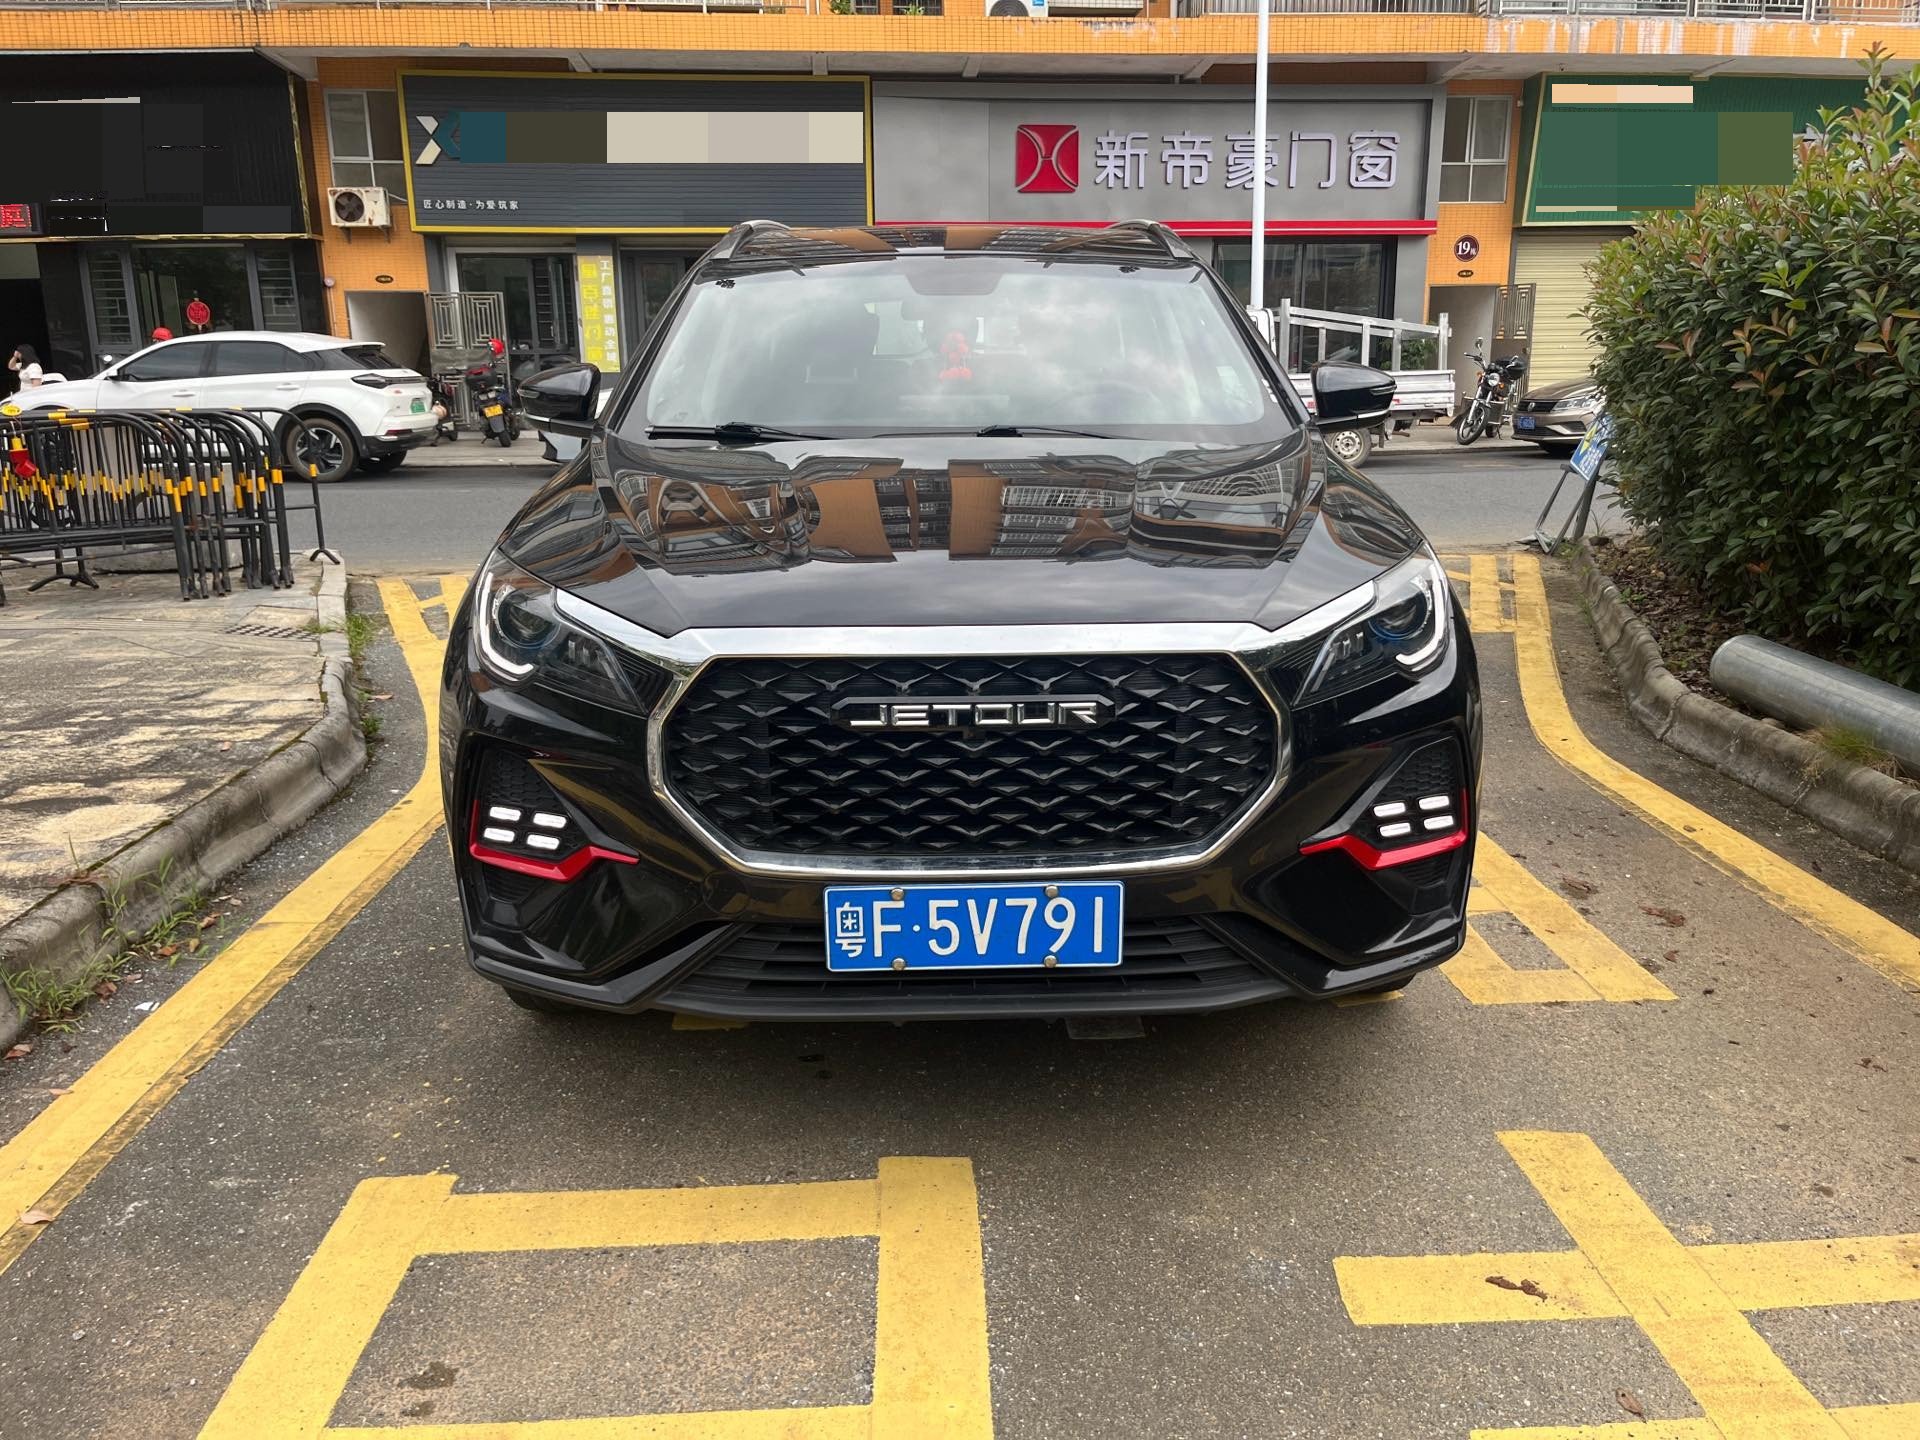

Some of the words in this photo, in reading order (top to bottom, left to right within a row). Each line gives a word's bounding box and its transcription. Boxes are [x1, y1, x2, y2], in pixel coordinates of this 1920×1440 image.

[1095, 129, 1400, 189] 新帝豪门窗
[849, 702, 1097, 726] JETOUR
